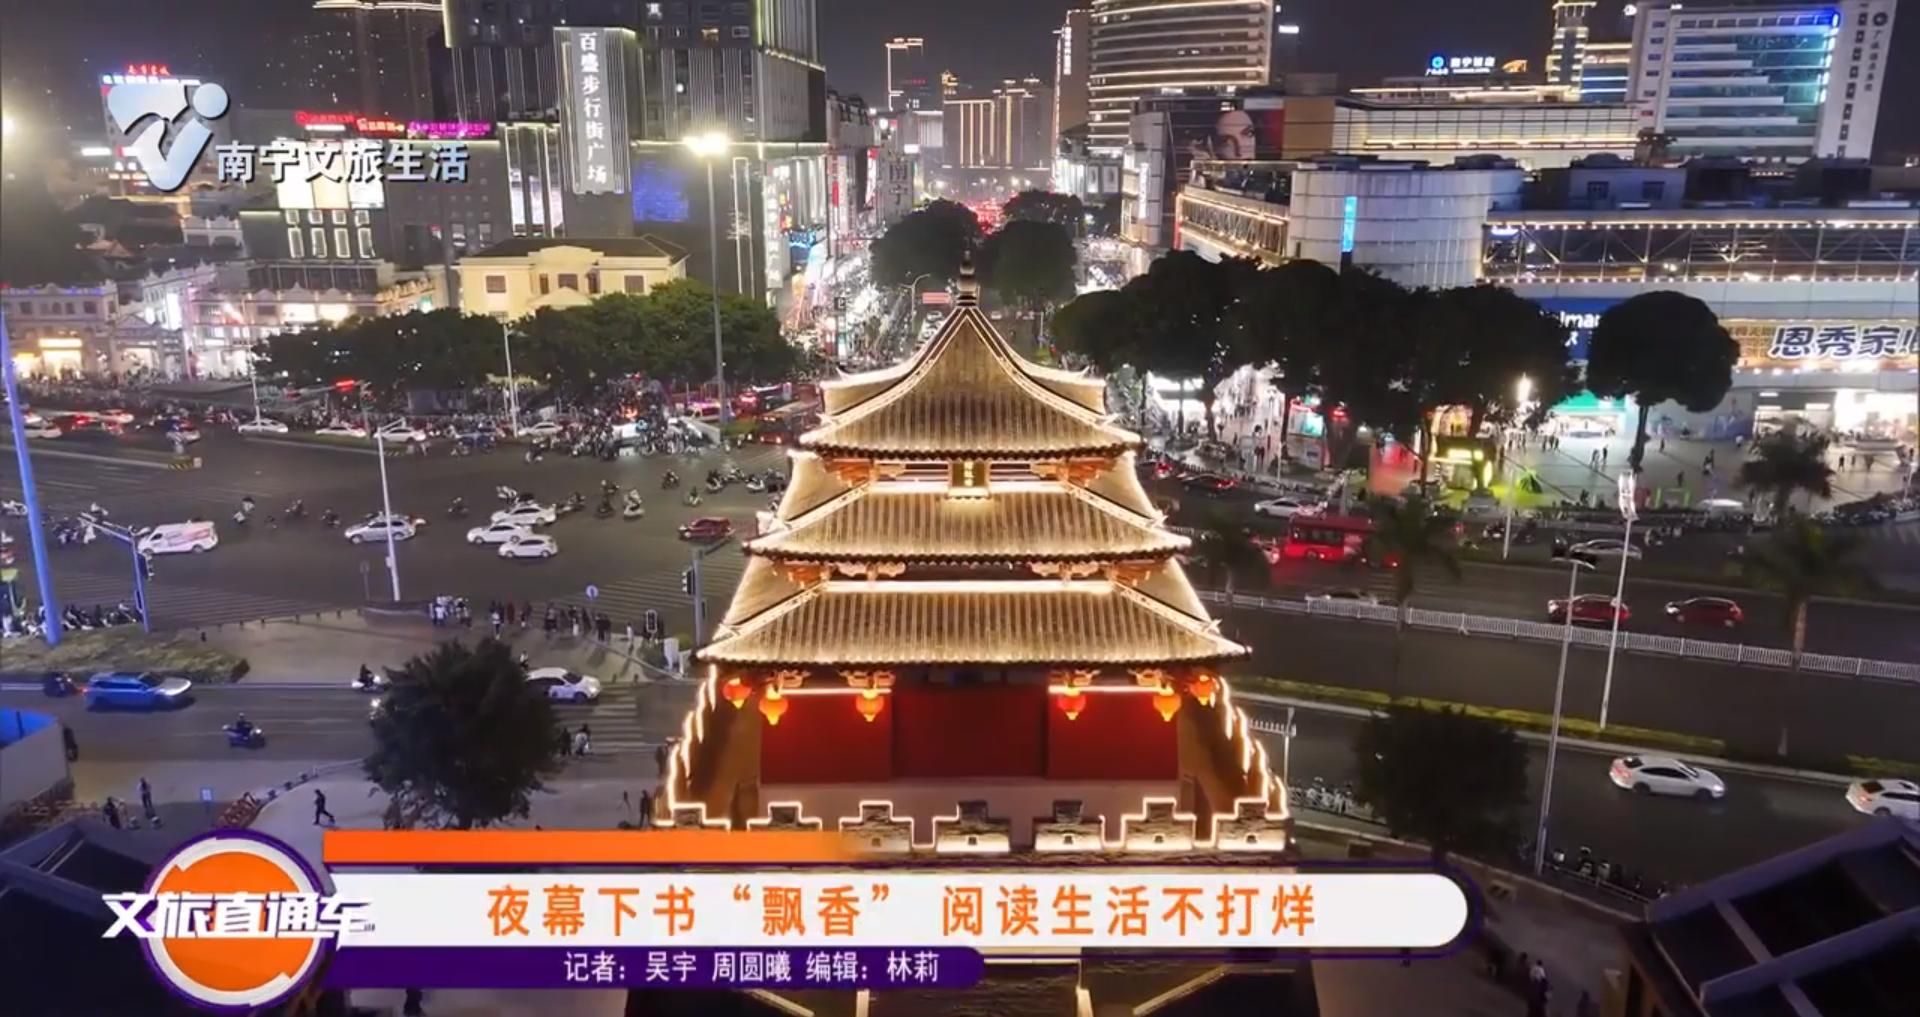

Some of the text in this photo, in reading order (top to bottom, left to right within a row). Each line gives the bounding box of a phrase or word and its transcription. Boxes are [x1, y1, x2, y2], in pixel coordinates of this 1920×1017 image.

[578, 31, 608, 185] 百盛步行街广场
